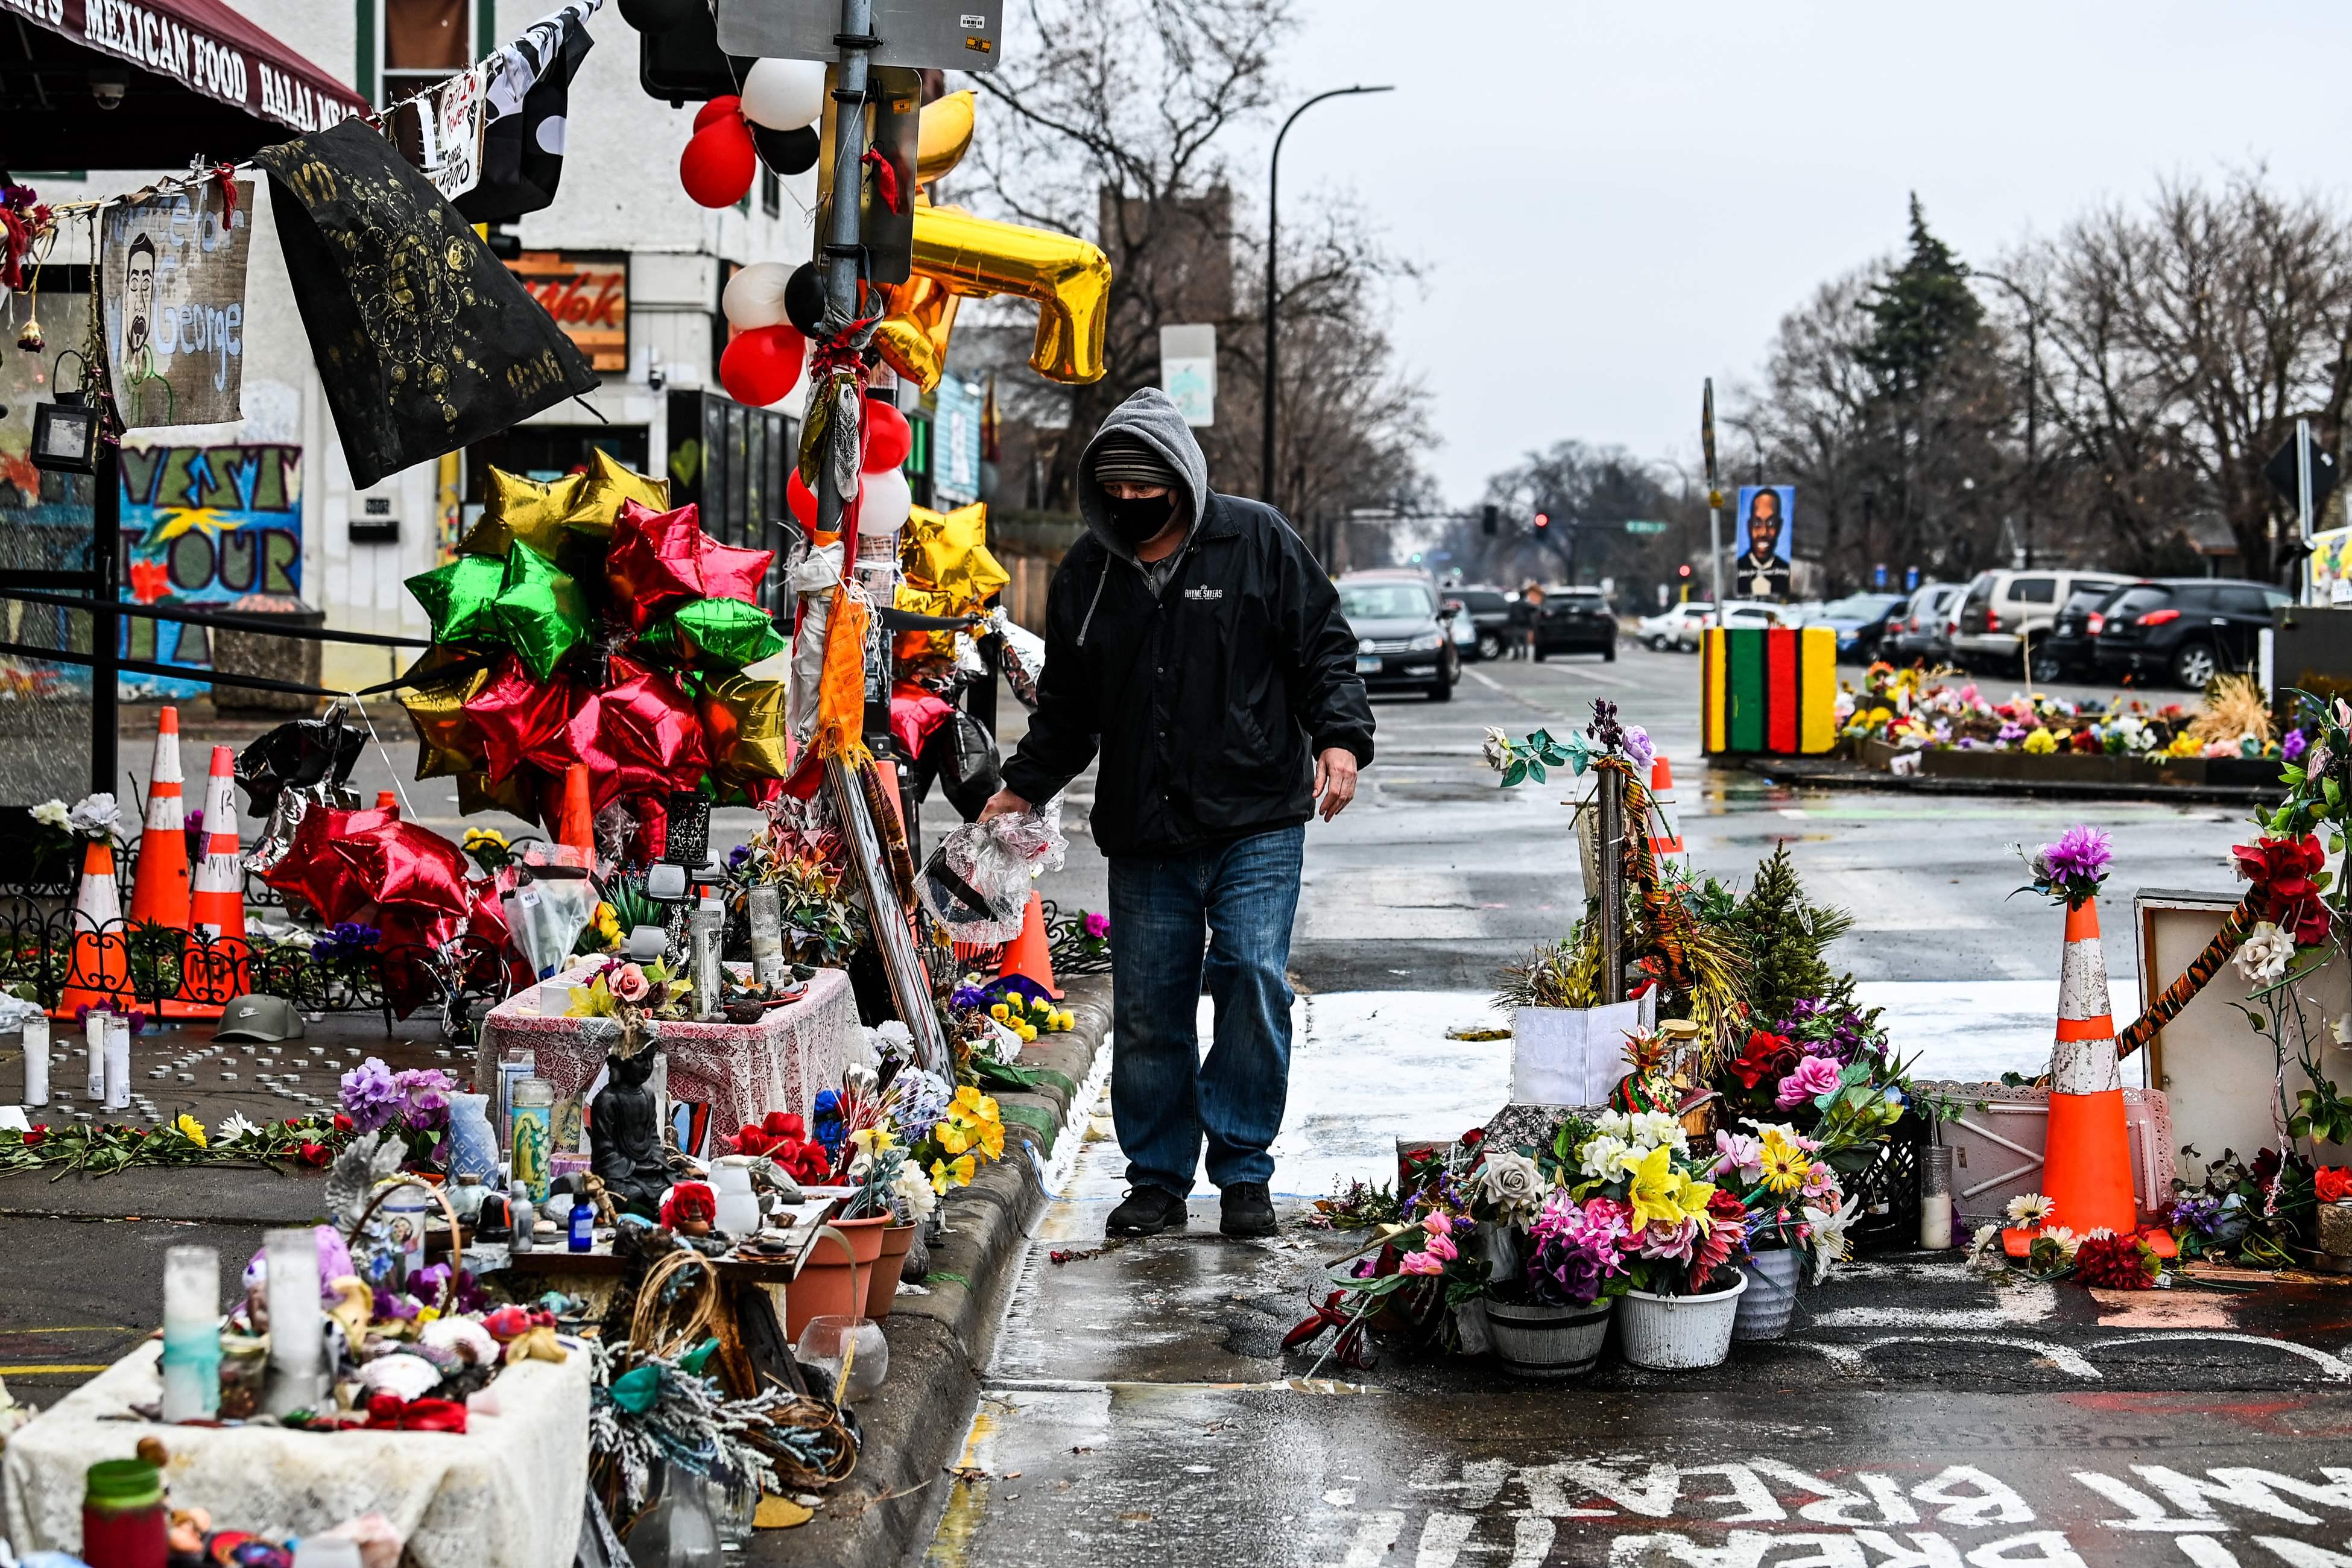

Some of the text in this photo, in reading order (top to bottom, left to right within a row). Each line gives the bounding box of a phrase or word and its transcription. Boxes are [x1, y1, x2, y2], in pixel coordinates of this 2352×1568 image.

[84, 0, 360, 134] MEXICAN FOOD HALAL ME
[153, 255, 242, 393] George
[1184, 589, 1222, 598] RHYME SAYERS
